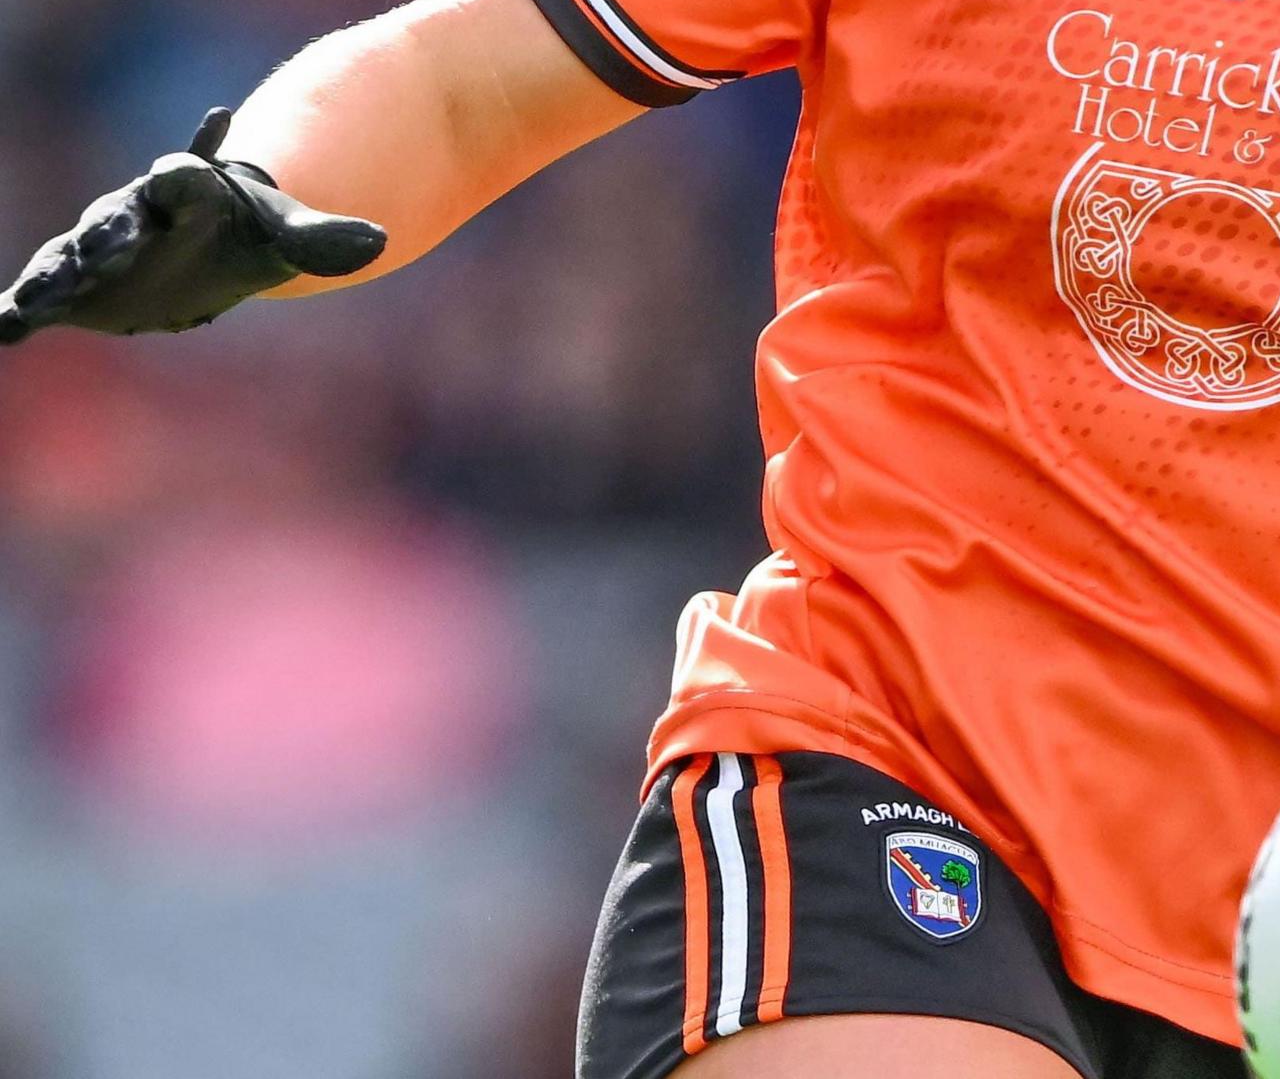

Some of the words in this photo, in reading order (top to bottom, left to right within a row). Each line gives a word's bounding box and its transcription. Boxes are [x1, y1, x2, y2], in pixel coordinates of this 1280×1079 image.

[1070, 82, 1217, 157] Hotel
[1232, 128, 1273, 165] &
[861, 802, 955, 828] ARMAGH
